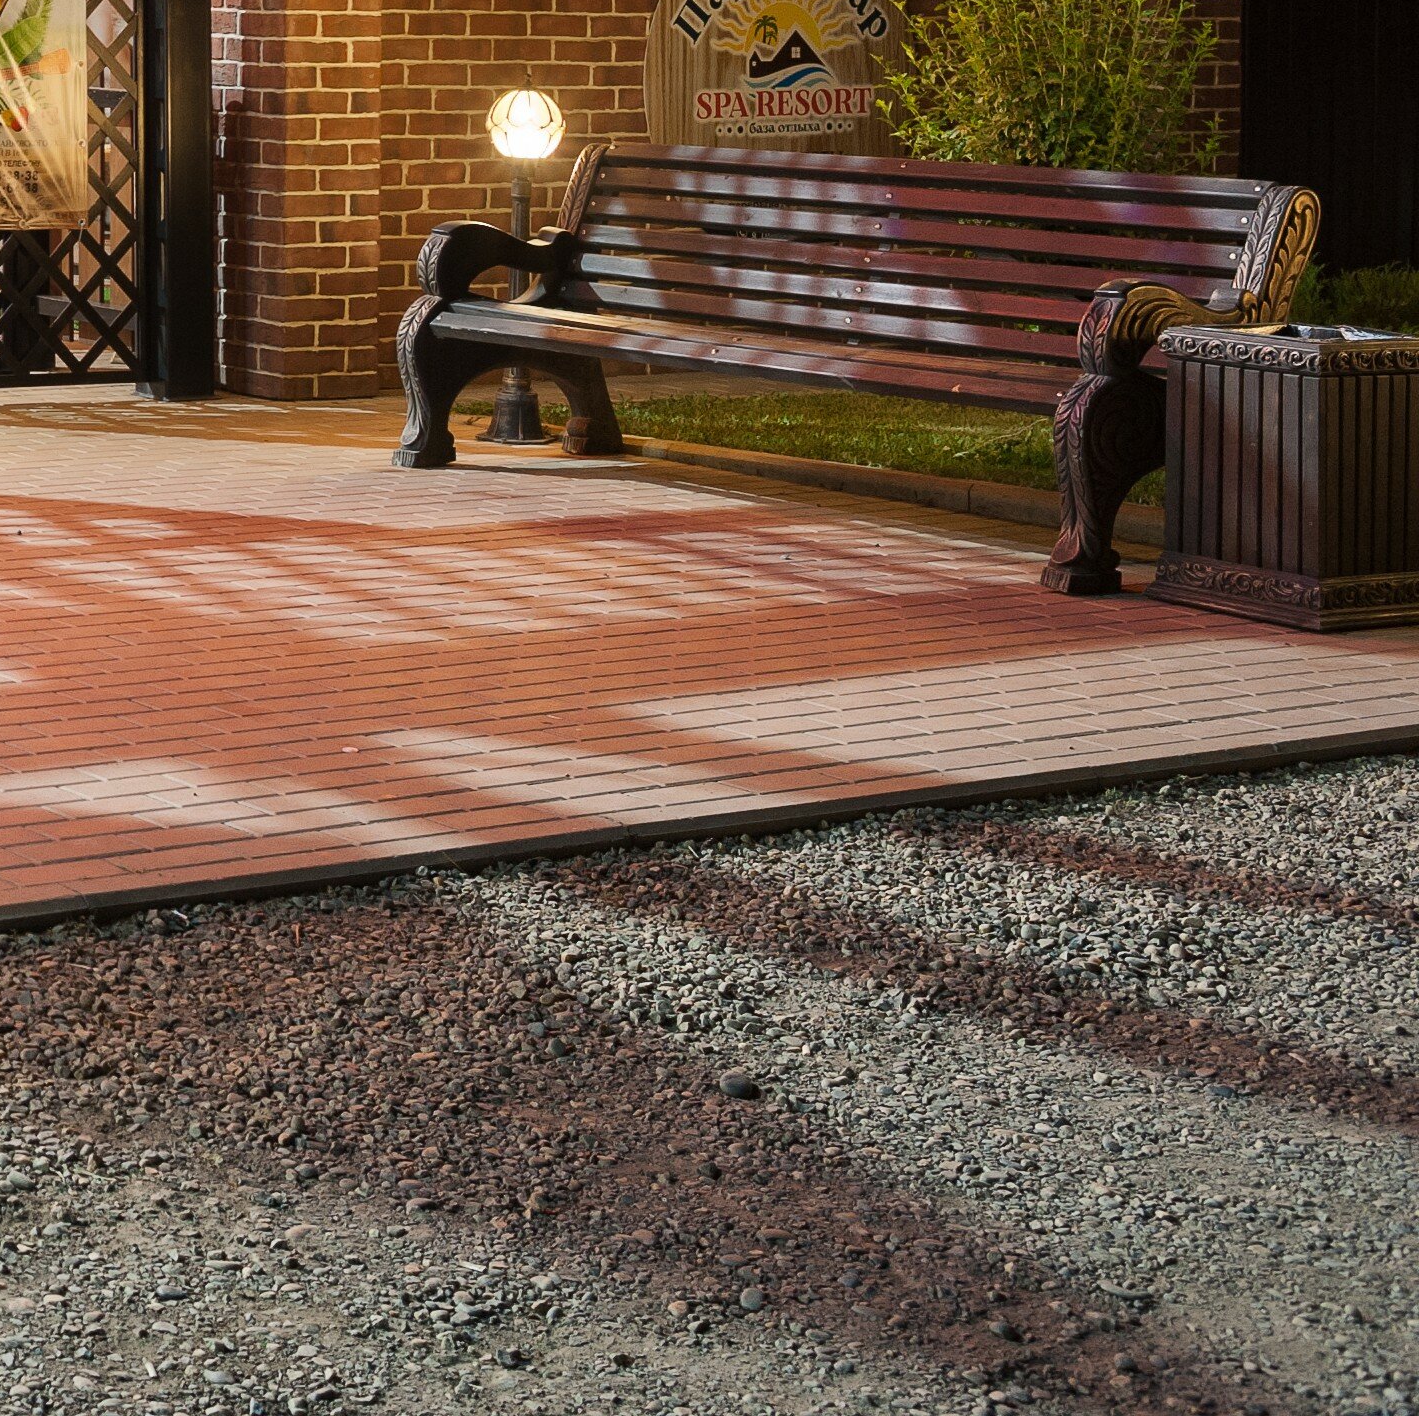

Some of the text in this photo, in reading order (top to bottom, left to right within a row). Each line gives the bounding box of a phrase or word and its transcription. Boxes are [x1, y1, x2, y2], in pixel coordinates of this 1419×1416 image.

[696, 86, 871, 120] SPA RESORT
[749, 122, 821, 134] база отдыха
